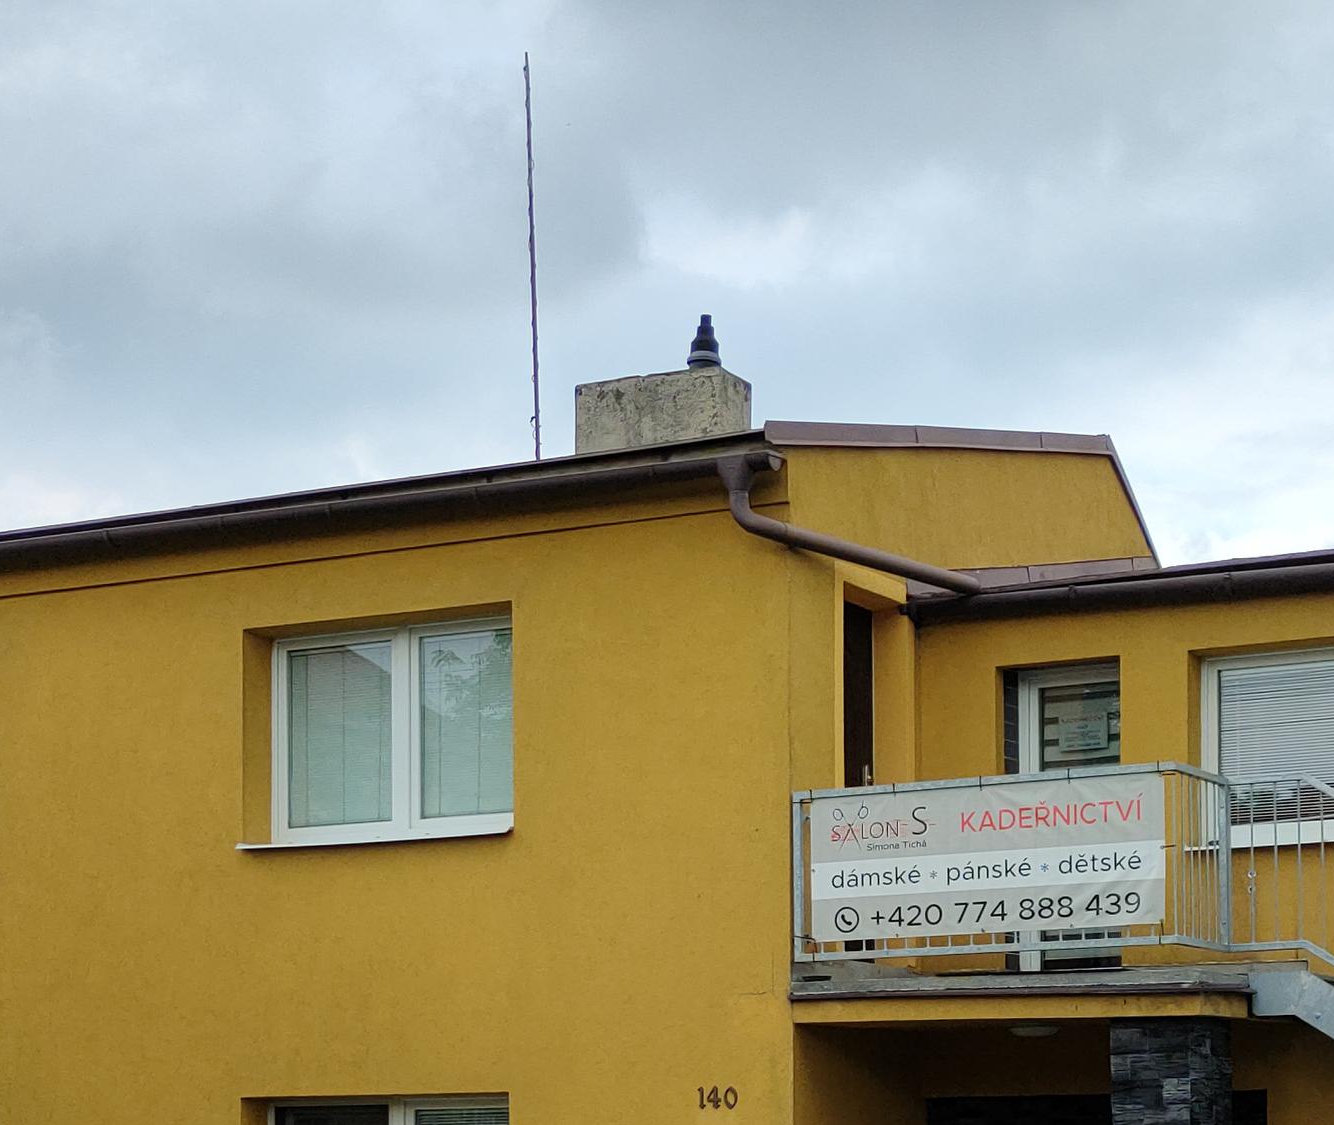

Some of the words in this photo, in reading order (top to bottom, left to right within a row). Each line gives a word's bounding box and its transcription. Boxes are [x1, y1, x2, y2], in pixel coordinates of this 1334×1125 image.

[960, 792, 1144, 833] KADEŘNICTVÍ
[866, 842, 900, 852] Simona
[902, 840, 927, 850] Tichá
[831, 864, 921, 889] dámské
[946, 858, 1032, 886] pánské
[1058, 850, 1142, 875] dětské
[870, 903, 943, 928] +420
[953, 899, 1008, 924] 774
[1018, 895, 1074, 921] 888
[1084, 891, 1141, 917] 439
[797, 1085, 839, 1110] 140
